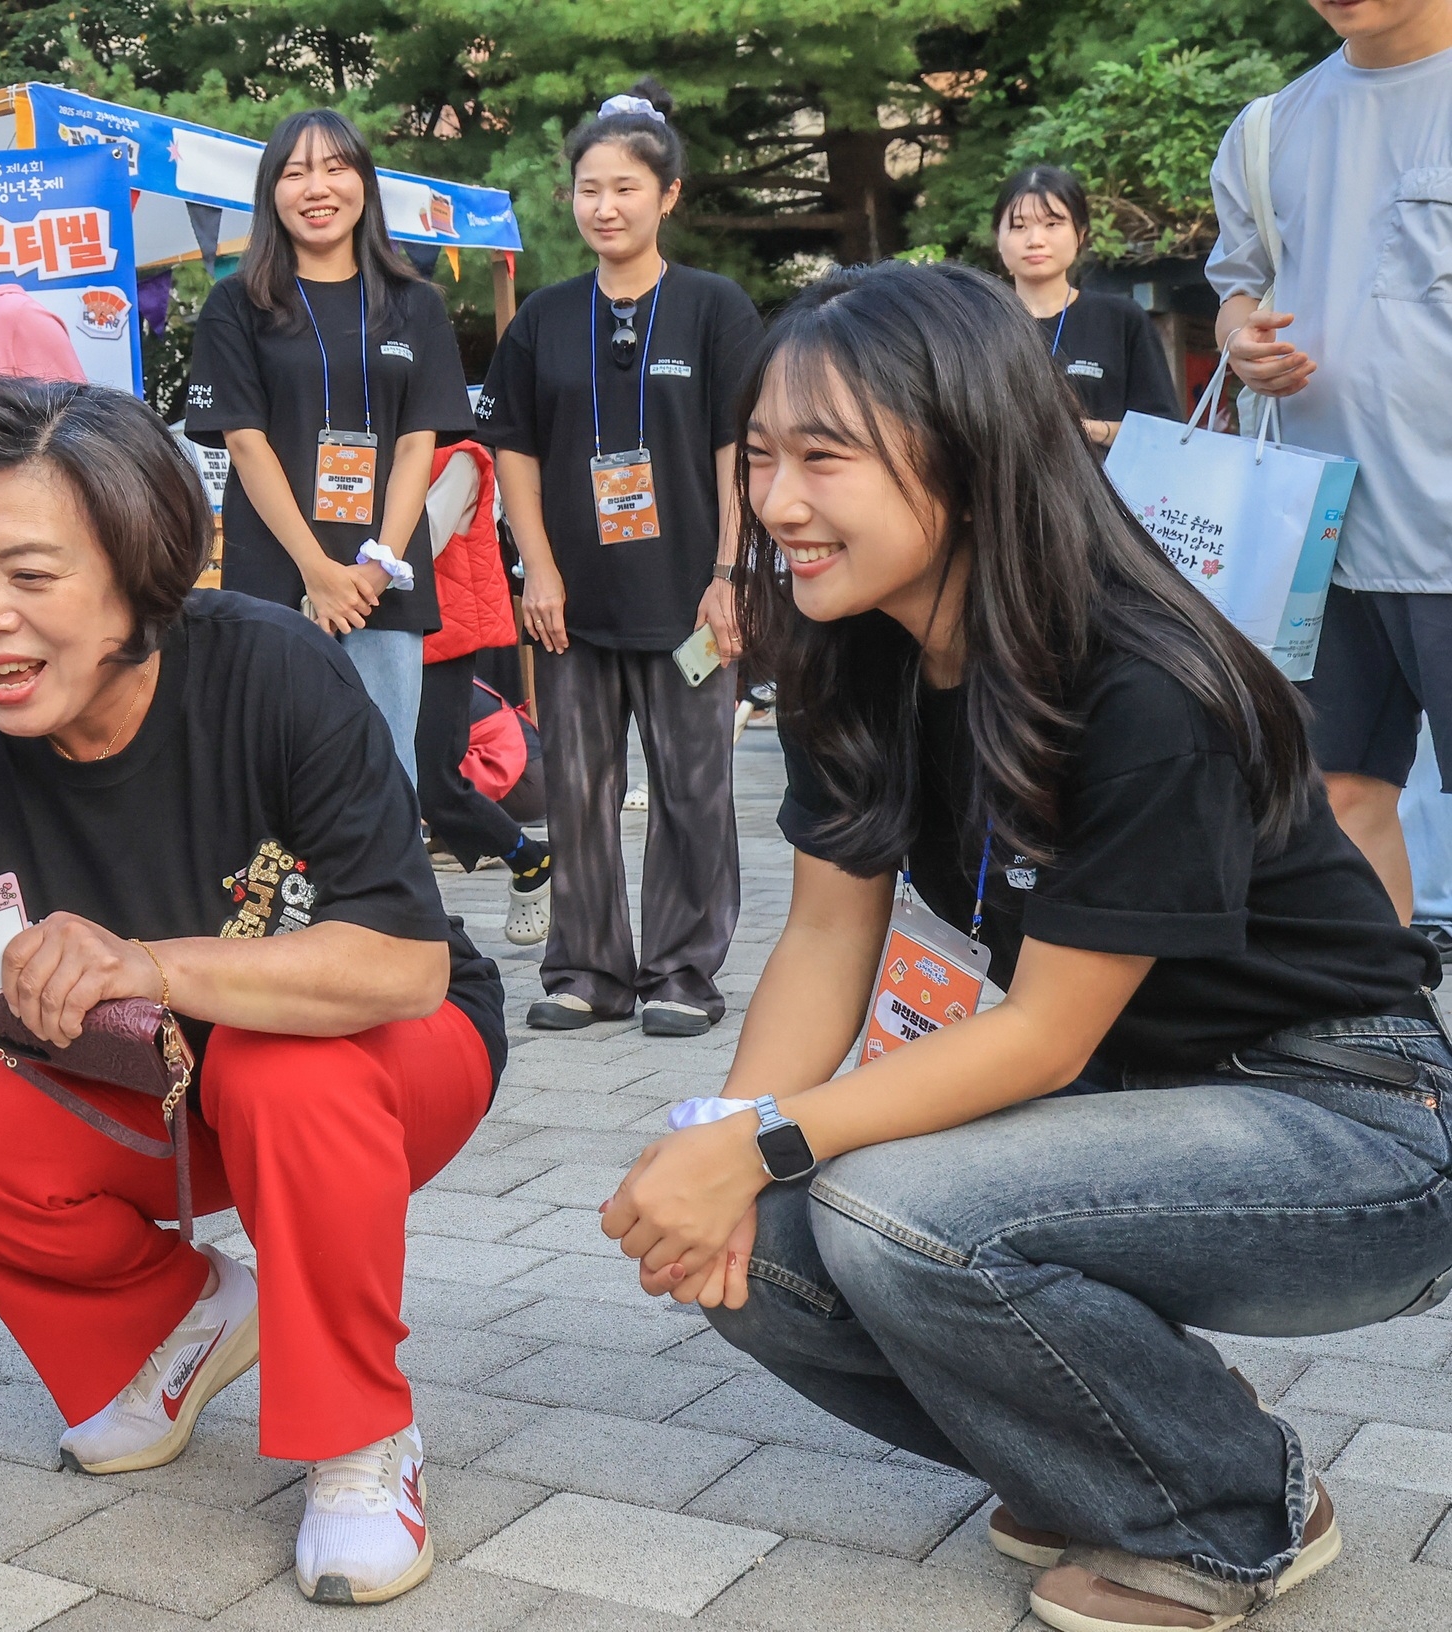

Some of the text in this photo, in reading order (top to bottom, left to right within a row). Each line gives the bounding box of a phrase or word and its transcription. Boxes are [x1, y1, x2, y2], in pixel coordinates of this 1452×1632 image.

[6, 160, 44, 175] 제4회
[1159, 509, 1223, 536] 지금도 충분해
[1156, 526, 1189, 545] 애쓰지
[1189, 535, 1225, 556] 않아도
